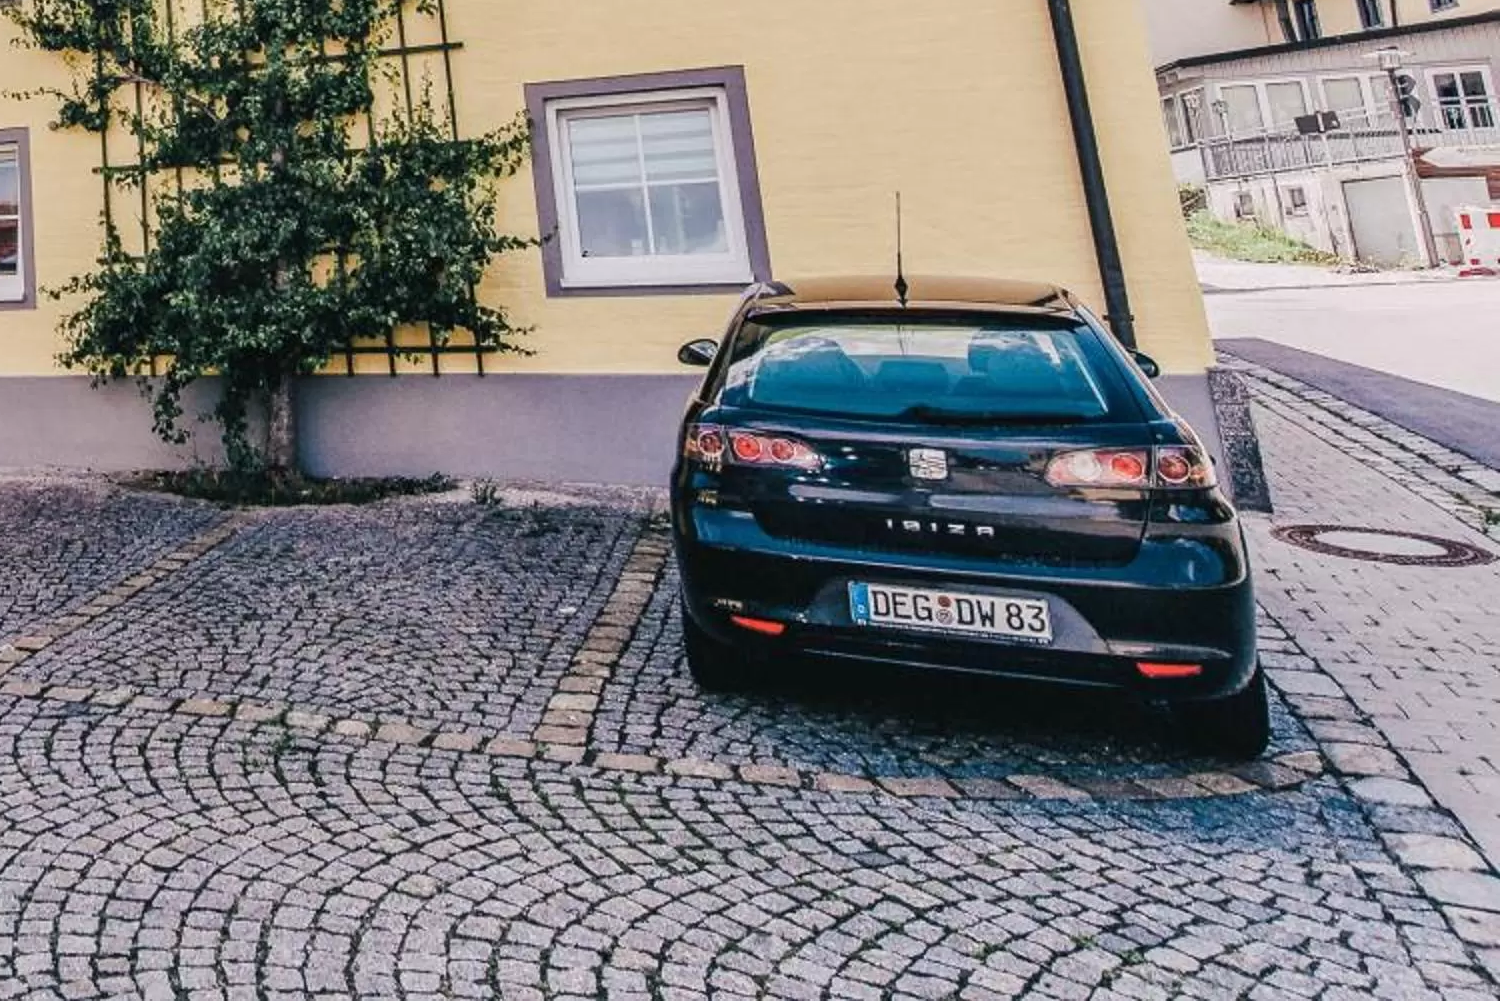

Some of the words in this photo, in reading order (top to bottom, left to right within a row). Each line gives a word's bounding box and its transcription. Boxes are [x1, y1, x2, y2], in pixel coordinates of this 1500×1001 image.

[886, 518, 995, 538] IBIZA
[871, 590, 934, 622] DEG
[954, 598, 996, 628] DW
[1005, 602, 1047, 633] 83
